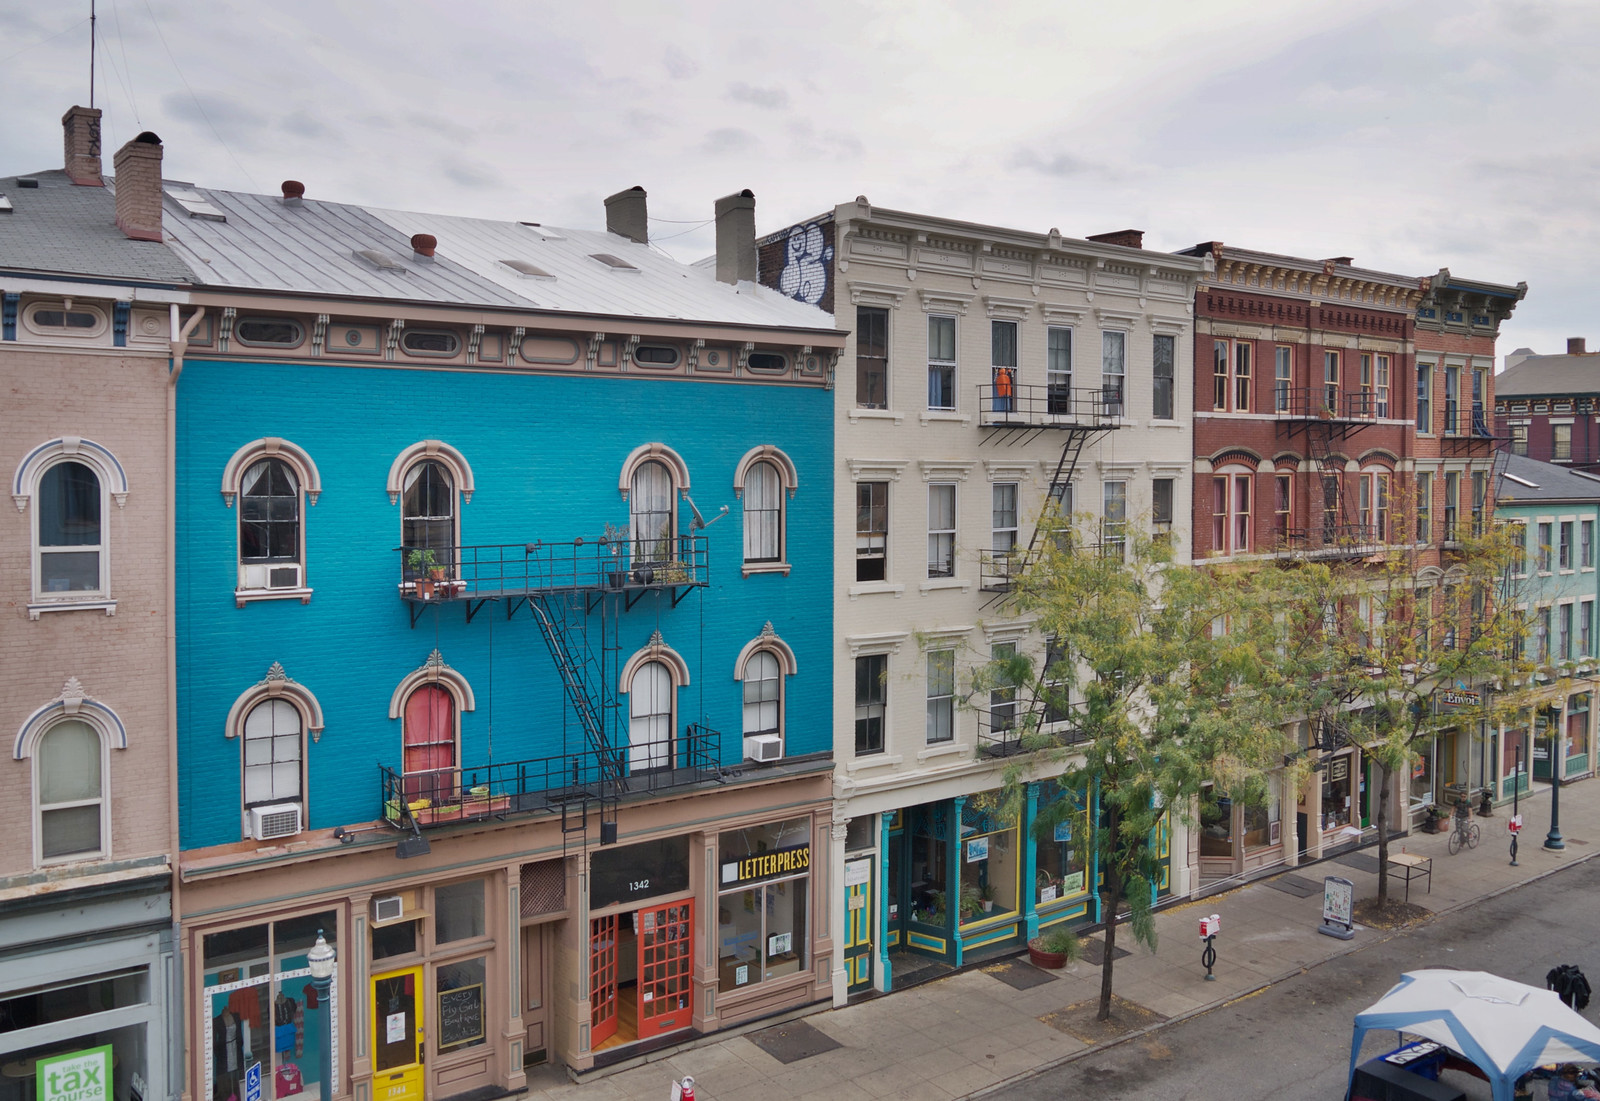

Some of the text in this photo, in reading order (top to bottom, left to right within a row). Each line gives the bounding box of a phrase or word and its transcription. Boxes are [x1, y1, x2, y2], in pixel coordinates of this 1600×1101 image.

[1448, 692, 1475, 705] Envoi
[739, 847, 809, 880] LETTERPRESS
[629, 879, 649, 891] 1342
[62, 1060, 98, 1073] take the
[47, 1066, 101, 1095] tax
